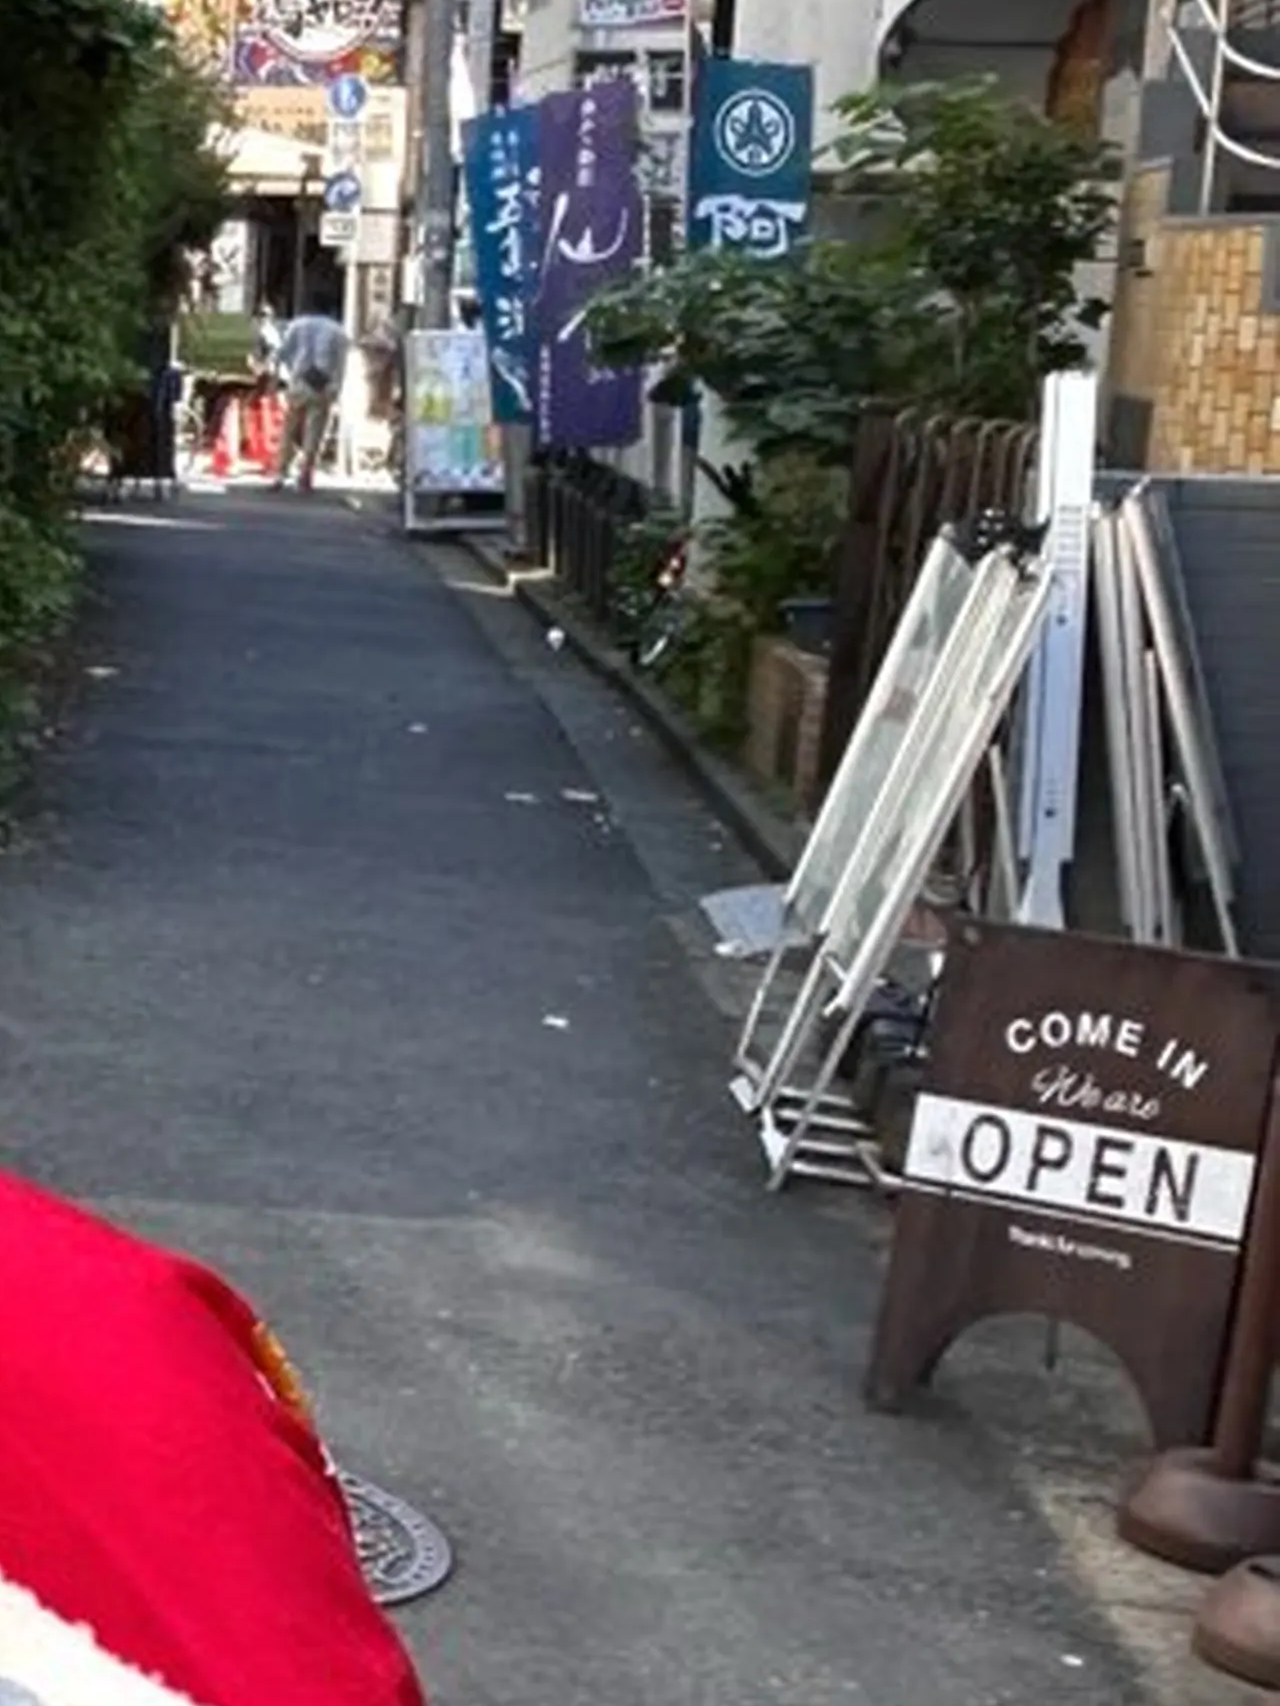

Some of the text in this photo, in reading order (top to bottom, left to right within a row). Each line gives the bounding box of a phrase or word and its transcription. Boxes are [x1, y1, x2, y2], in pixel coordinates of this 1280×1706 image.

[1006, 1011, 1208, 1090] COME IN
[1031, 1064, 1161, 1120] We are
[960, 1113, 1201, 1222] OPEN
